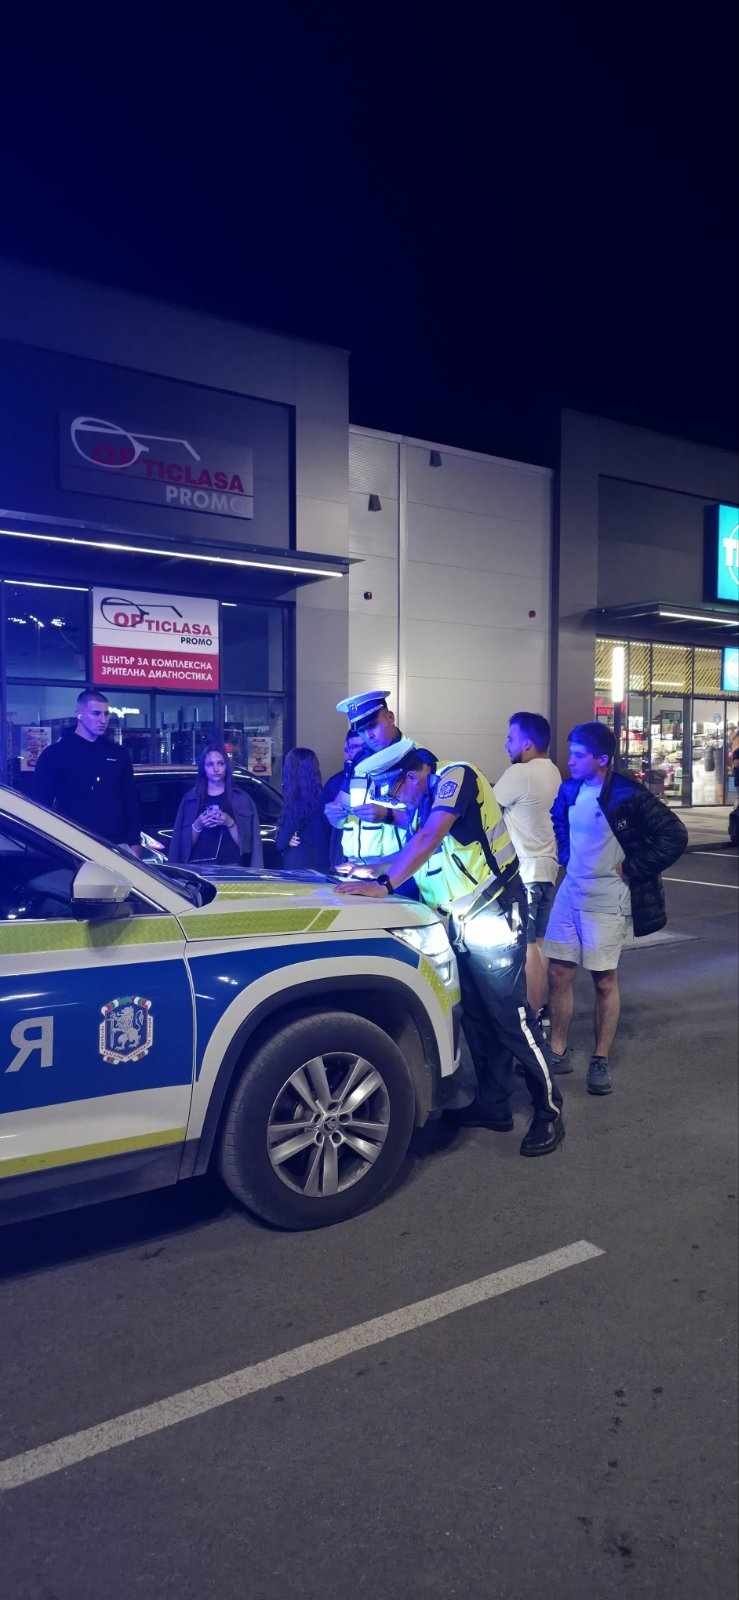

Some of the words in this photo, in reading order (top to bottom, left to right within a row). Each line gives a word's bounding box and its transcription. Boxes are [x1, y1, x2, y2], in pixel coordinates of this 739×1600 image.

[166, 485, 246, 514] PROMO
[113, 612, 212, 636] OPTICLASA
[180, 636, 213, 646] PROMO
[101, 655, 135, 665] ЦЕНТЪР
[137, 657, 149, 666] ЗА
[151, 658, 213, 670] КОМПЛЕКСНА
[101, 666, 146, 678] ЗРИТЕЛНА
[148, 670, 213, 681] ДИАГНОСТИКА
[5, 1015, 54, 1073] Я
